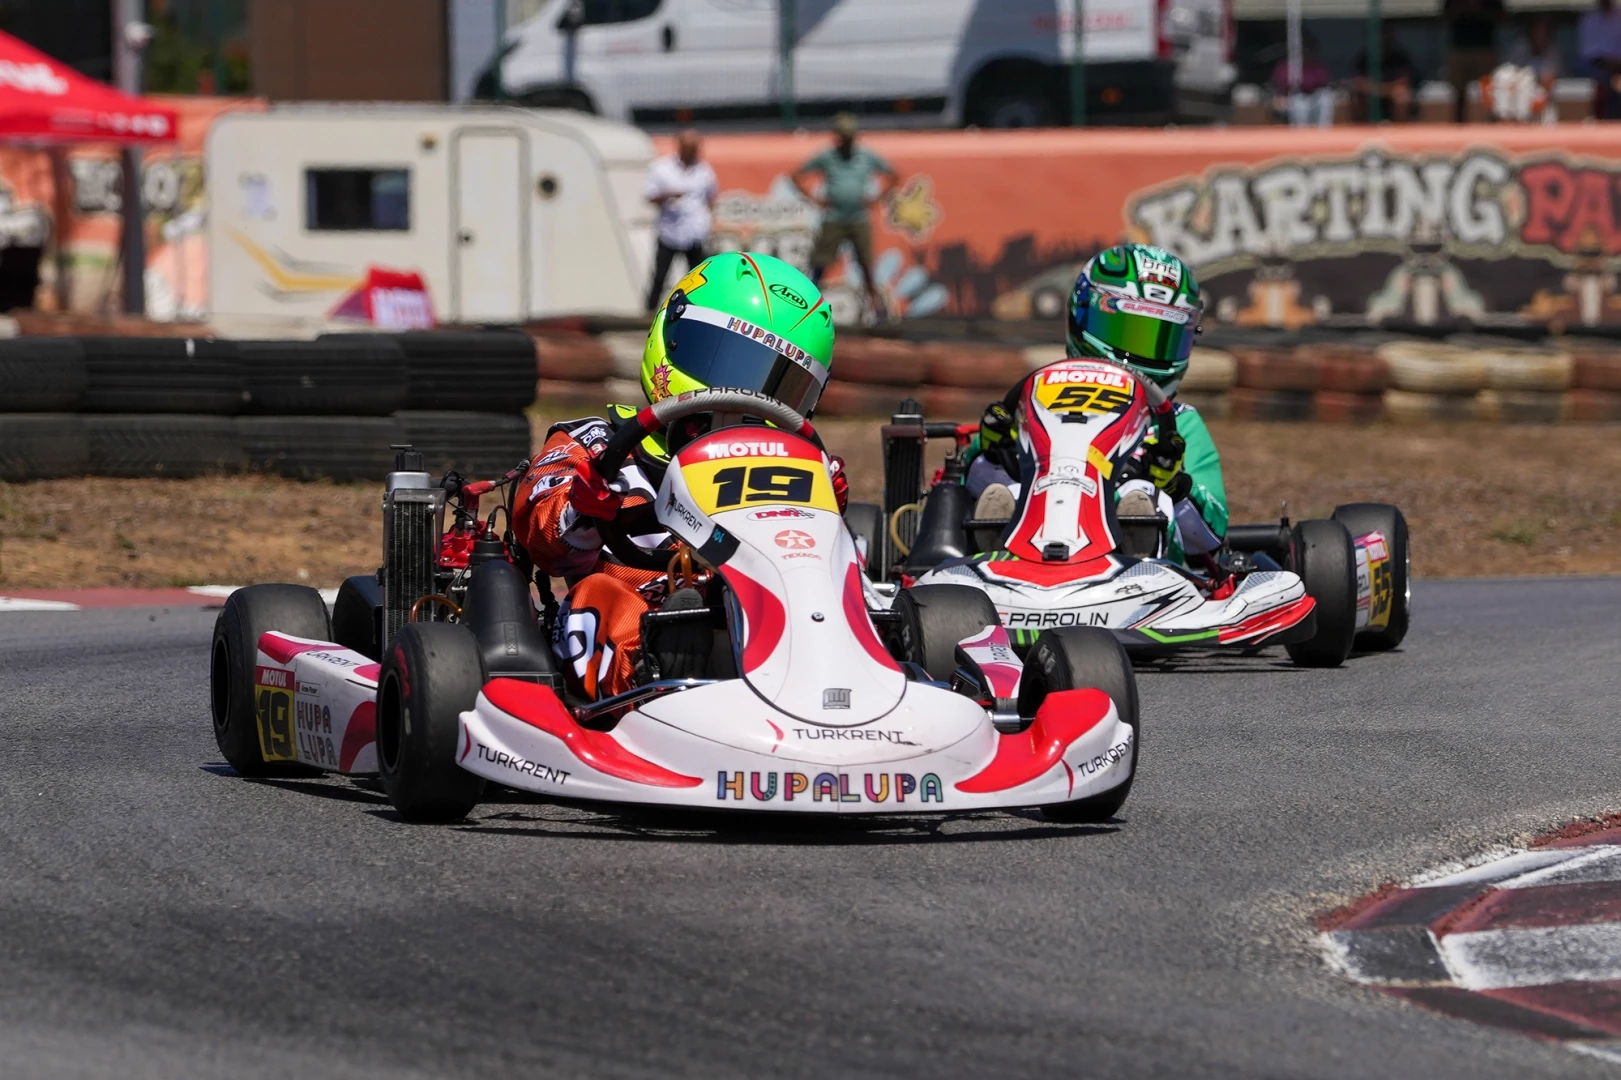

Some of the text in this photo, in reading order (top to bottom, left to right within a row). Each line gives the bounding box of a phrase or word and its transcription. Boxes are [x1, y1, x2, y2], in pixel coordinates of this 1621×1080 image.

[780, 283, 805, 306] Arai
[726, 317, 813, 370] HUPALUPA
[1046, 370, 1126, 388] MOTUL
[1047, 386, 1134, 415] 55
[708, 441, 789, 460] MOTUL
[713, 465, 815, 509] 19
[781, 552, 823, 560] TEXACO
[261, 669, 287, 688] MOTUL
[258, 689, 294, 759] 19
[296, 701, 333, 734] HUPA
[299, 732, 338, 767] LUPA
[792, 728, 905, 743] TURKRENT
[476, 743, 572, 786] TURKRENT
[716, 770, 944, 803] HUPALUPA
